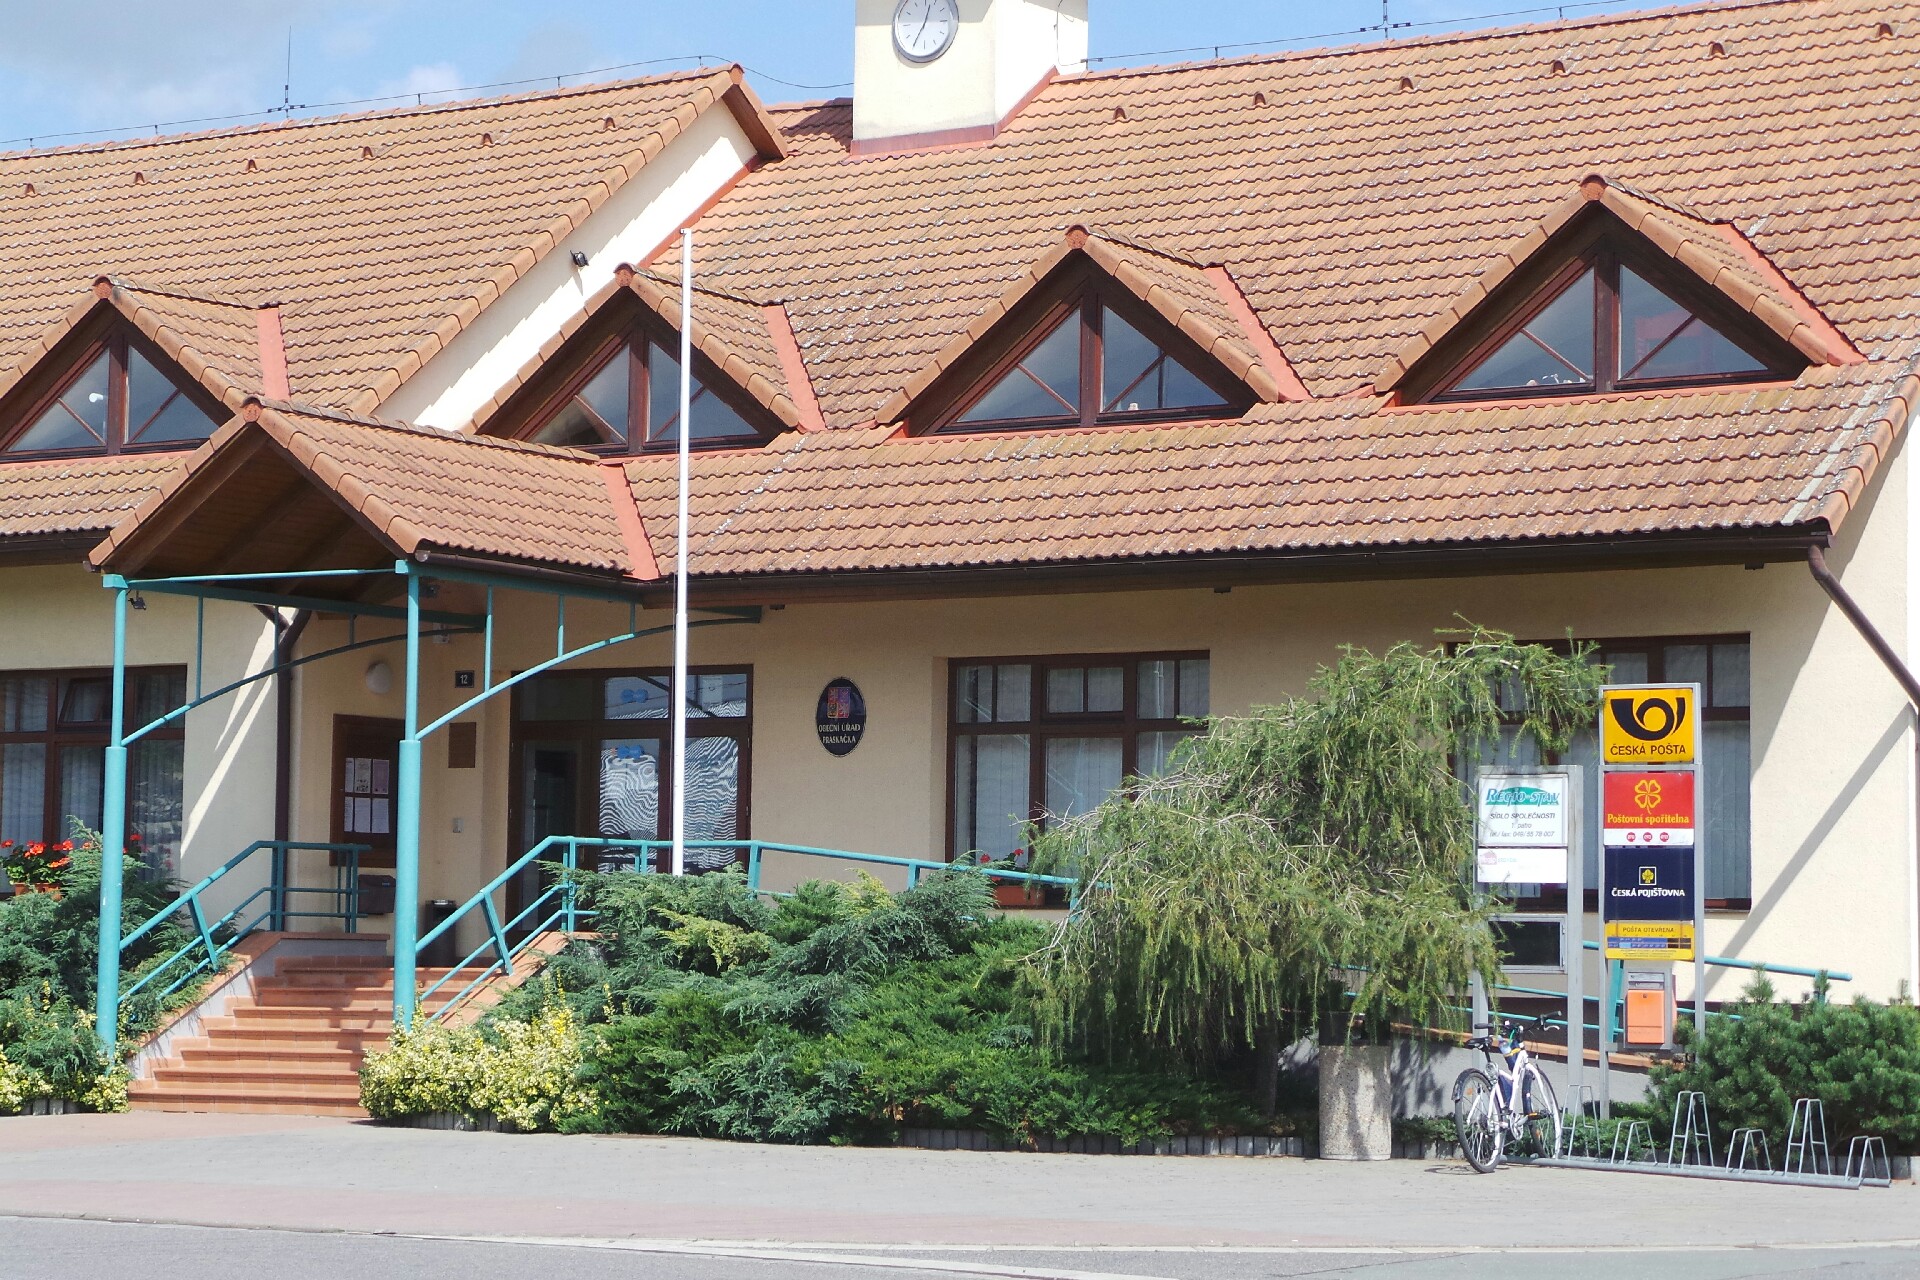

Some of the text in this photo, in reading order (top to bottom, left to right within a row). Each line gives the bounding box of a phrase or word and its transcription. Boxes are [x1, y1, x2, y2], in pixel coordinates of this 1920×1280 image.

[460, 674, 468, 685] 12
[1610, 743, 1686, 756] ČESKÁ POŠTA
[1511, 811, 1556, 820] SPOLEČNOSTI
[1607, 813, 1690, 826] Poštovní spořitelna
[1611, 887, 1686, 898] ČESKÁ POJIŠŤOVNA
[1622, 925, 1642, 933] POŠTA
